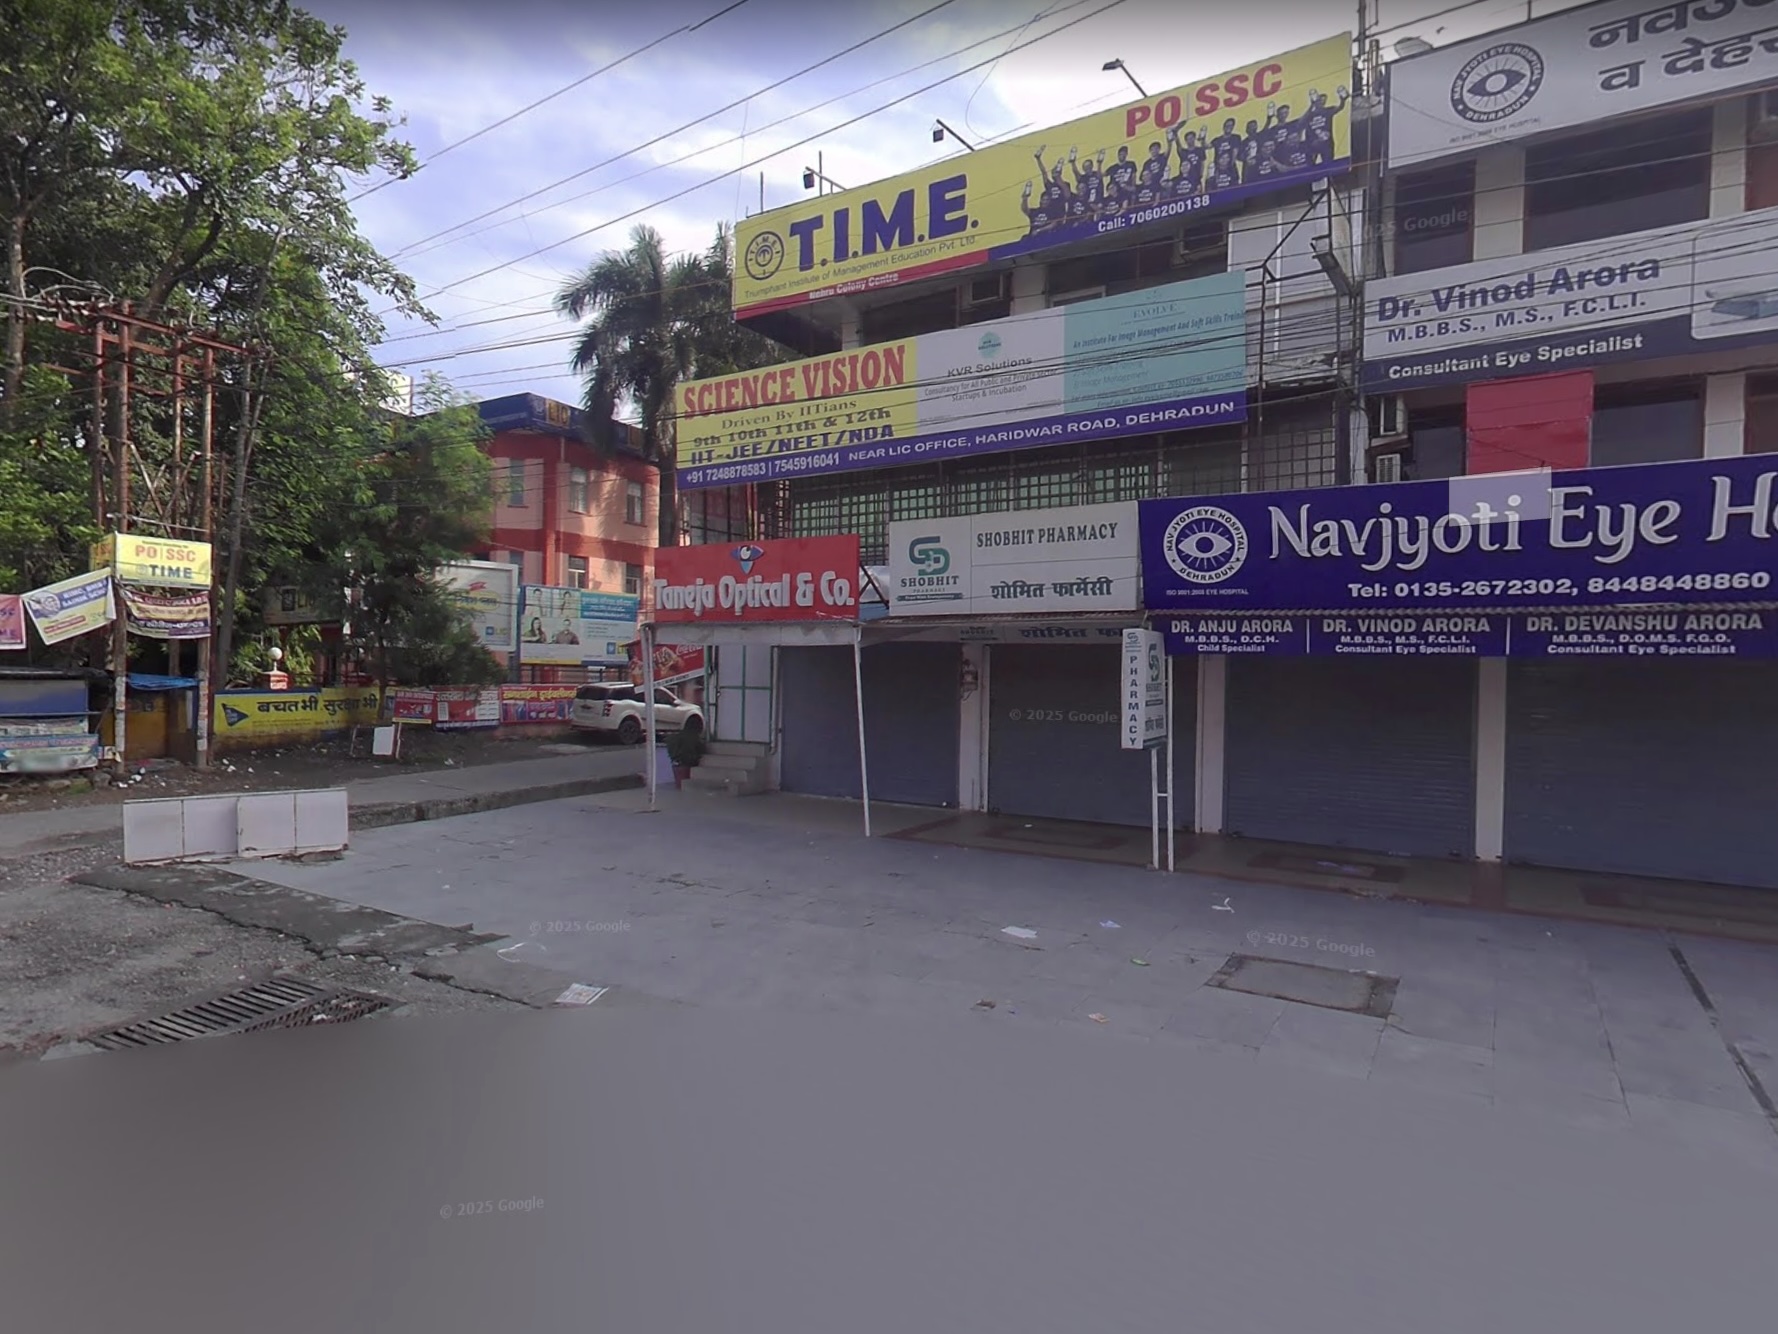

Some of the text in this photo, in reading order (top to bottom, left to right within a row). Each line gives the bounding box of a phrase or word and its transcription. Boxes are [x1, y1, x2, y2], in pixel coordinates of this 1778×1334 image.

[1489, 45, 1513, 55] EYE
[1513, 45, 1542, 81] HOSPITAL
[1598, 59, 1646, 91] व
[1126, 63, 1283, 138] PO SSC
[1465, 95, 1529, 120] DEHRADUN
[789, 174, 979, 272] T.I.M.E.
[1098, 194, 1211, 233] Call: 7060200138
[744, 281, 787, 300] Triumphant
[788, 274, 820, 287] Institute
[822, 271, 831, 281] of
[833, 259, 889, 279] Management
[892, 246, 937, 262] Education
[836, 280, 867, 295] Colony
[868, 273, 899, 287] Centre
[1377, 258, 1660, 322] Dr. Vinod Arora
[1133, 303, 1178, 319] EVOLVE
[1388, 292, 1646, 344] M.B.B.S., M.S., F.C.L.I.
[947, 357, 1033, 378] KVR Solutions
[1388, 333, 1643, 379] Consultant Eye Specialist
[684, 344, 906, 420] SCIENCE VISION
[924, 384, 960, 397] Consultancy
[960, 382, 970, 391] for
[971, 380, 979, 388] All
[980, 376, 1000, 387] Public
[952, 390, 980, 402] Startups
[989, 384, 1027, 396] Incubation
[694, 407, 891, 448] 9th 10th 11th & 12th
[722, 400, 857, 430] Driven By IITians
[686, 401, 1235, 485] +91 7248878583 7545916041 NEAR LIC OFFICE, HARIDWAR ROAD, DEHRADUN
[976, 522, 1118, 547] SHOBHIT PHARMACY
[1166, 508, 1245, 552] NAV JYOTI EYE HOSPITAL
[1267, 494, 1523, 572] Navjyoti
[1547, 485, 1681, 564] Eye
[135, 544, 157, 559] PO
[166, 547, 196, 562] SSC
[900, 575, 960, 588] SHOBHIT
[1179, 564, 1235, 581] DEHRADUN
[1348, 572, 1771, 598] Tel: 0135-2672302, 8448448860
[654, 570, 855, 617] Taneja Optical & Co.
[1171, 618, 1293, 633] DR. ANJU ARORA
[1322, 617, 1491, 633] DR. VINOD ARORA
[1526, 613, 1763, 631] DR. DEVANSHU ARORA
[1197, 644, 1265, 653] Child Specialist
[1335, 644, 1476, 654] Consultant Eye Specialist
[1547, 644, 1736, 655] Consultant Eye Specialist
[256, 701, 299, 713] बचत
[301, 695, 319, 711] भी
[1128, 655, 1139, 745] PHARMACY
